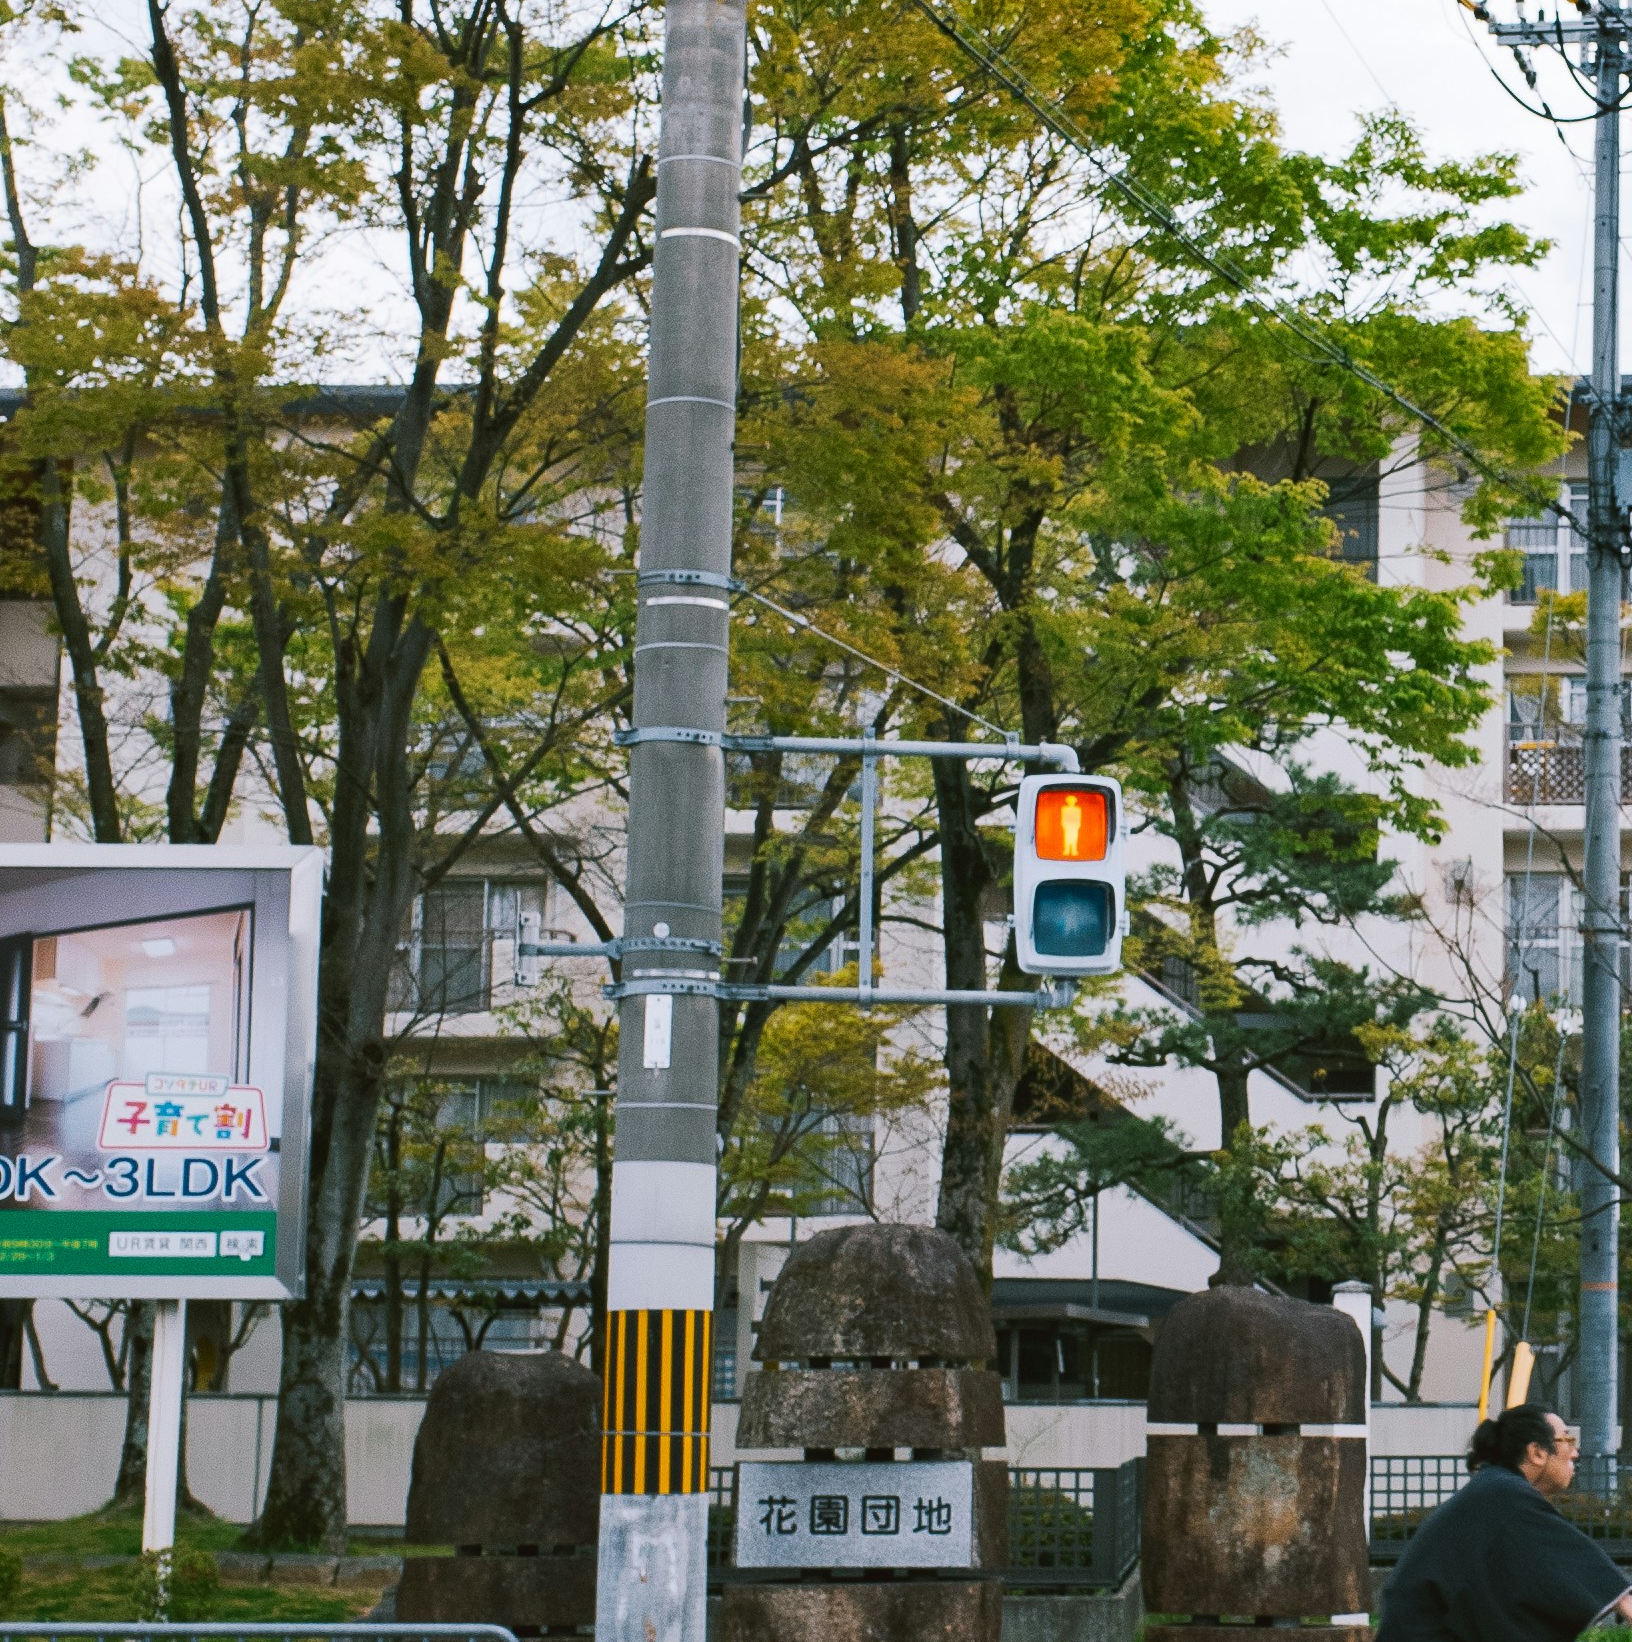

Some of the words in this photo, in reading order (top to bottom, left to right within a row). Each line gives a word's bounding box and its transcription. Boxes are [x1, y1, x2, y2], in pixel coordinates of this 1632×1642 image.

[117, 1100, 252, 1139] 子育て割
[758, 1495, 952, 1536] 花園団地
